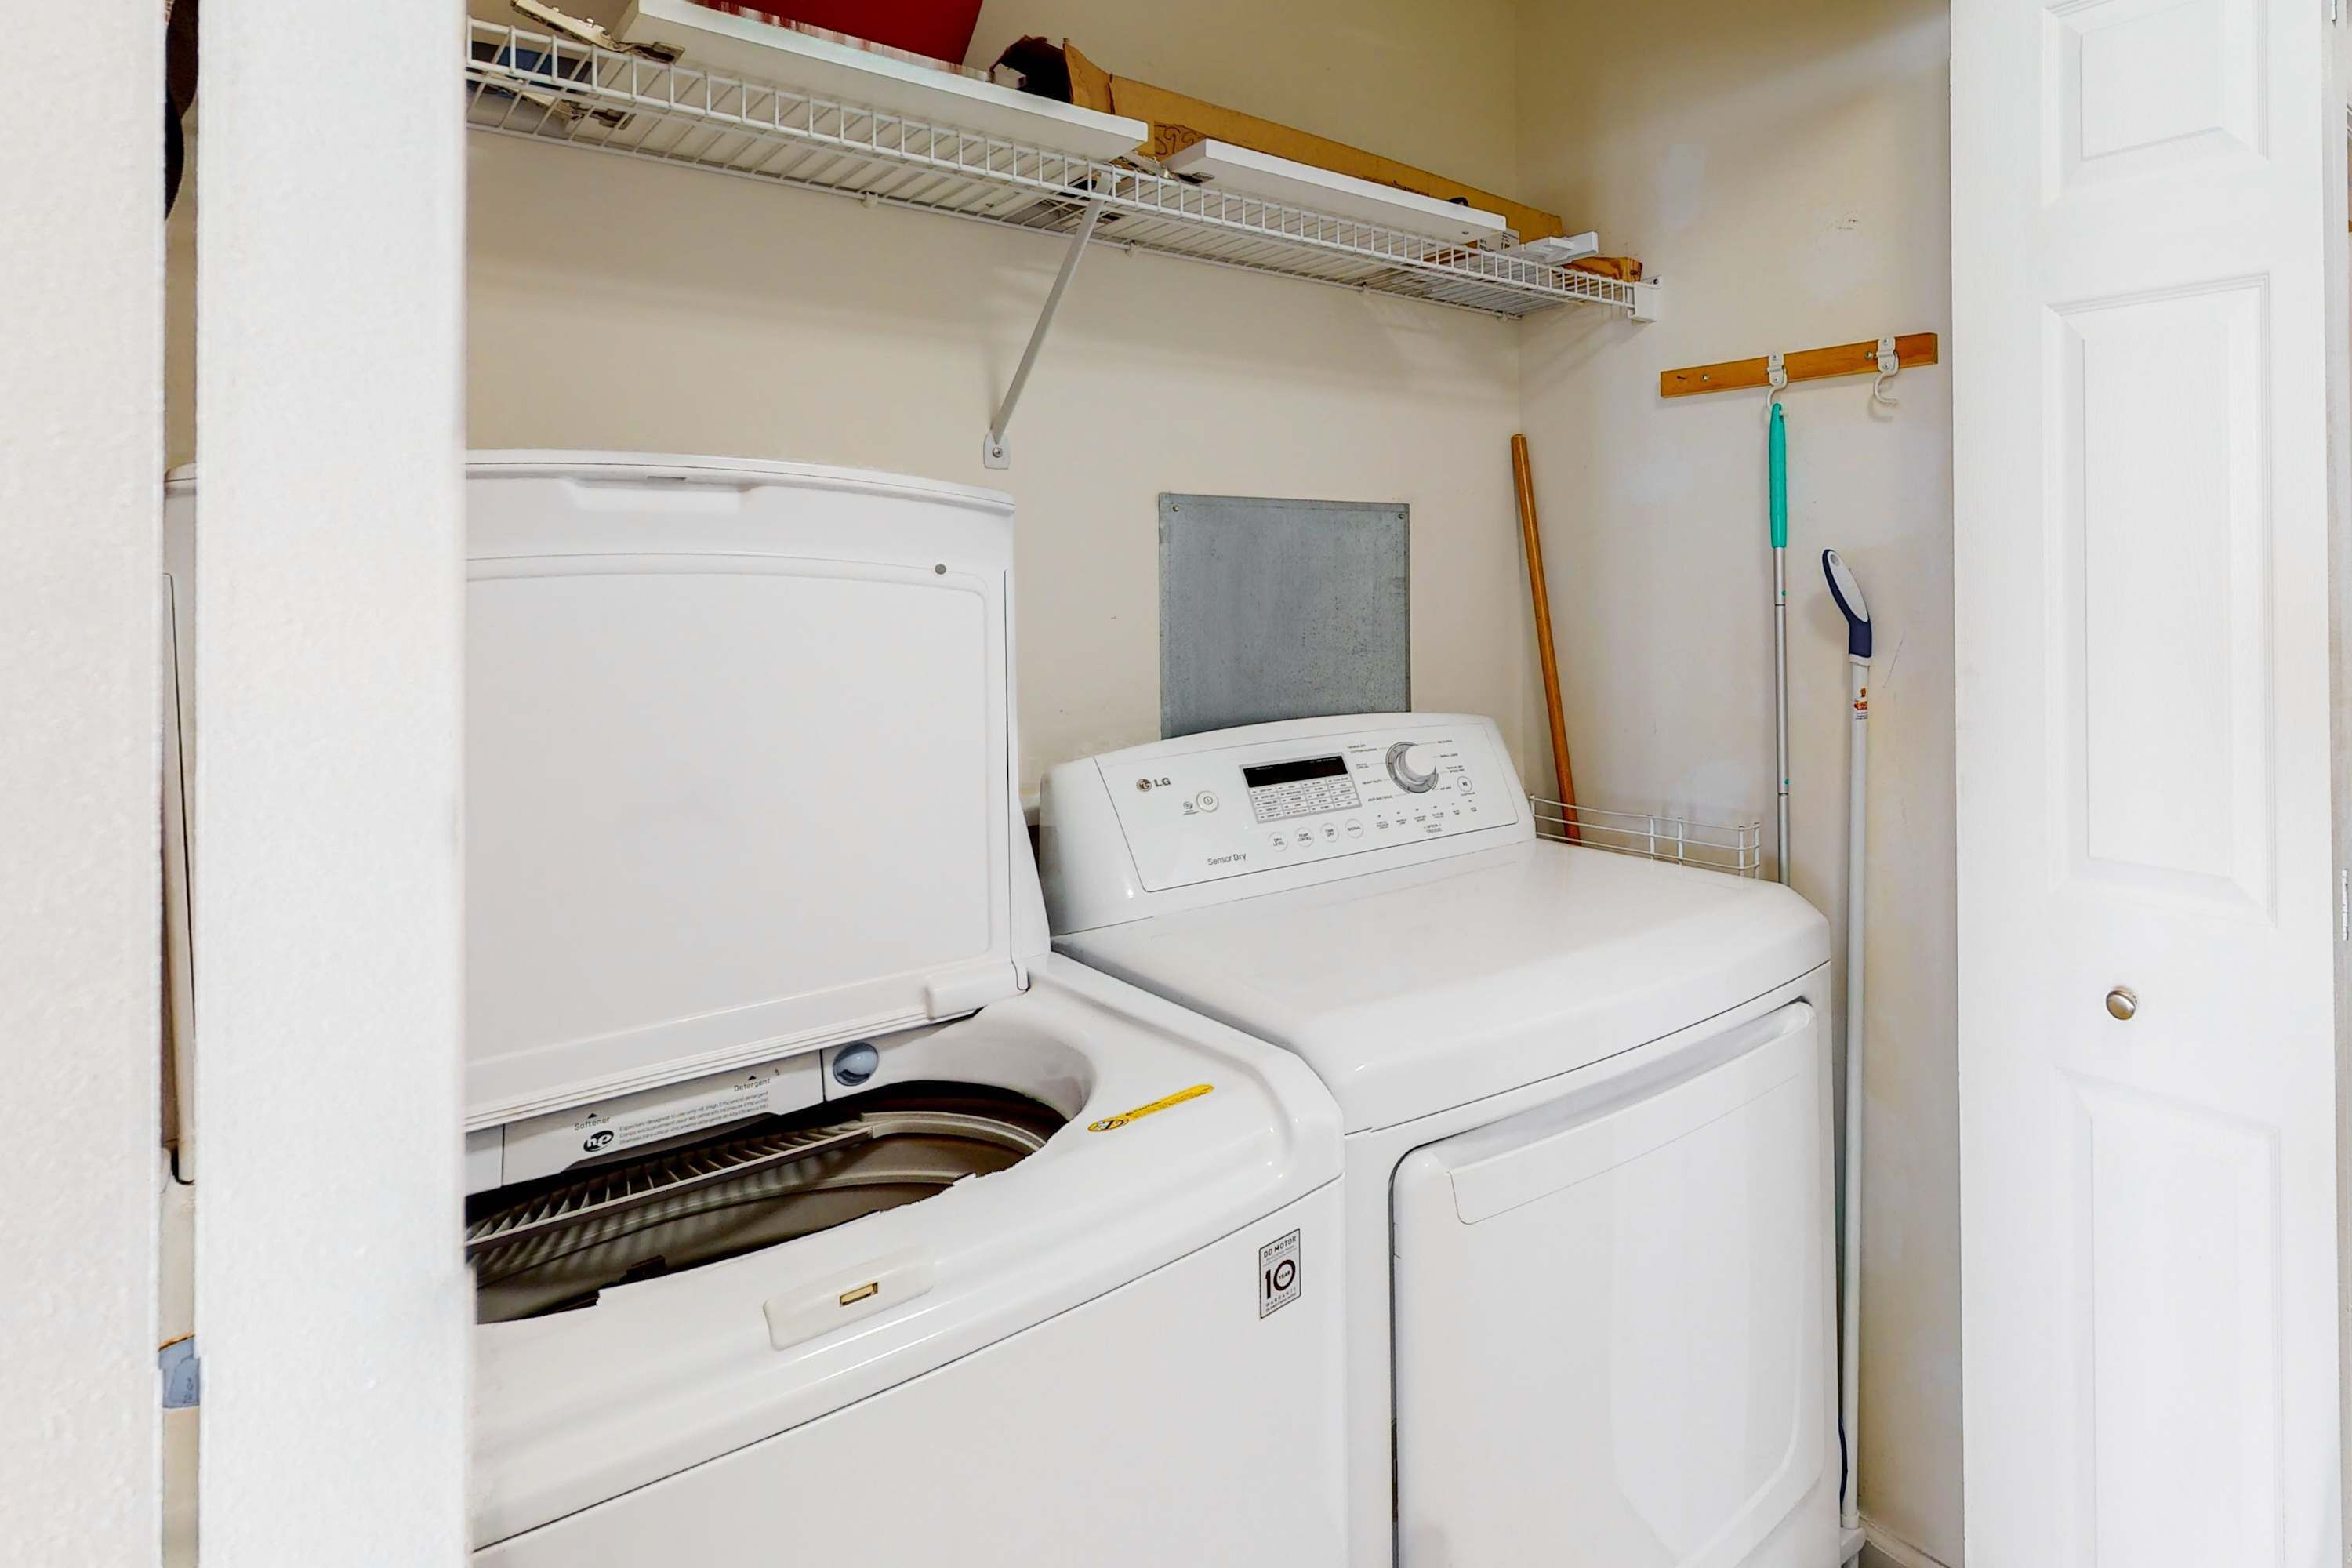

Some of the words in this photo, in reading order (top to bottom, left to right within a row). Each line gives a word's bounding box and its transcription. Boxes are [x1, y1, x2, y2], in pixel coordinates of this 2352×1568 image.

[1153, 777, 1171, 787] LG
[1207, 855, 1232, 866] Sensor
[1232, 853, 1247, 862] Dry
[733, 1078, 771, 1092] Detergent
[574, 1116, 610, 1131] Softener
[1274, 1236, 1297, 1252] MOTOR
[1265, 1259, 1296, 1299] 10
[1279, 1270, 1290, 1280] YEAR
